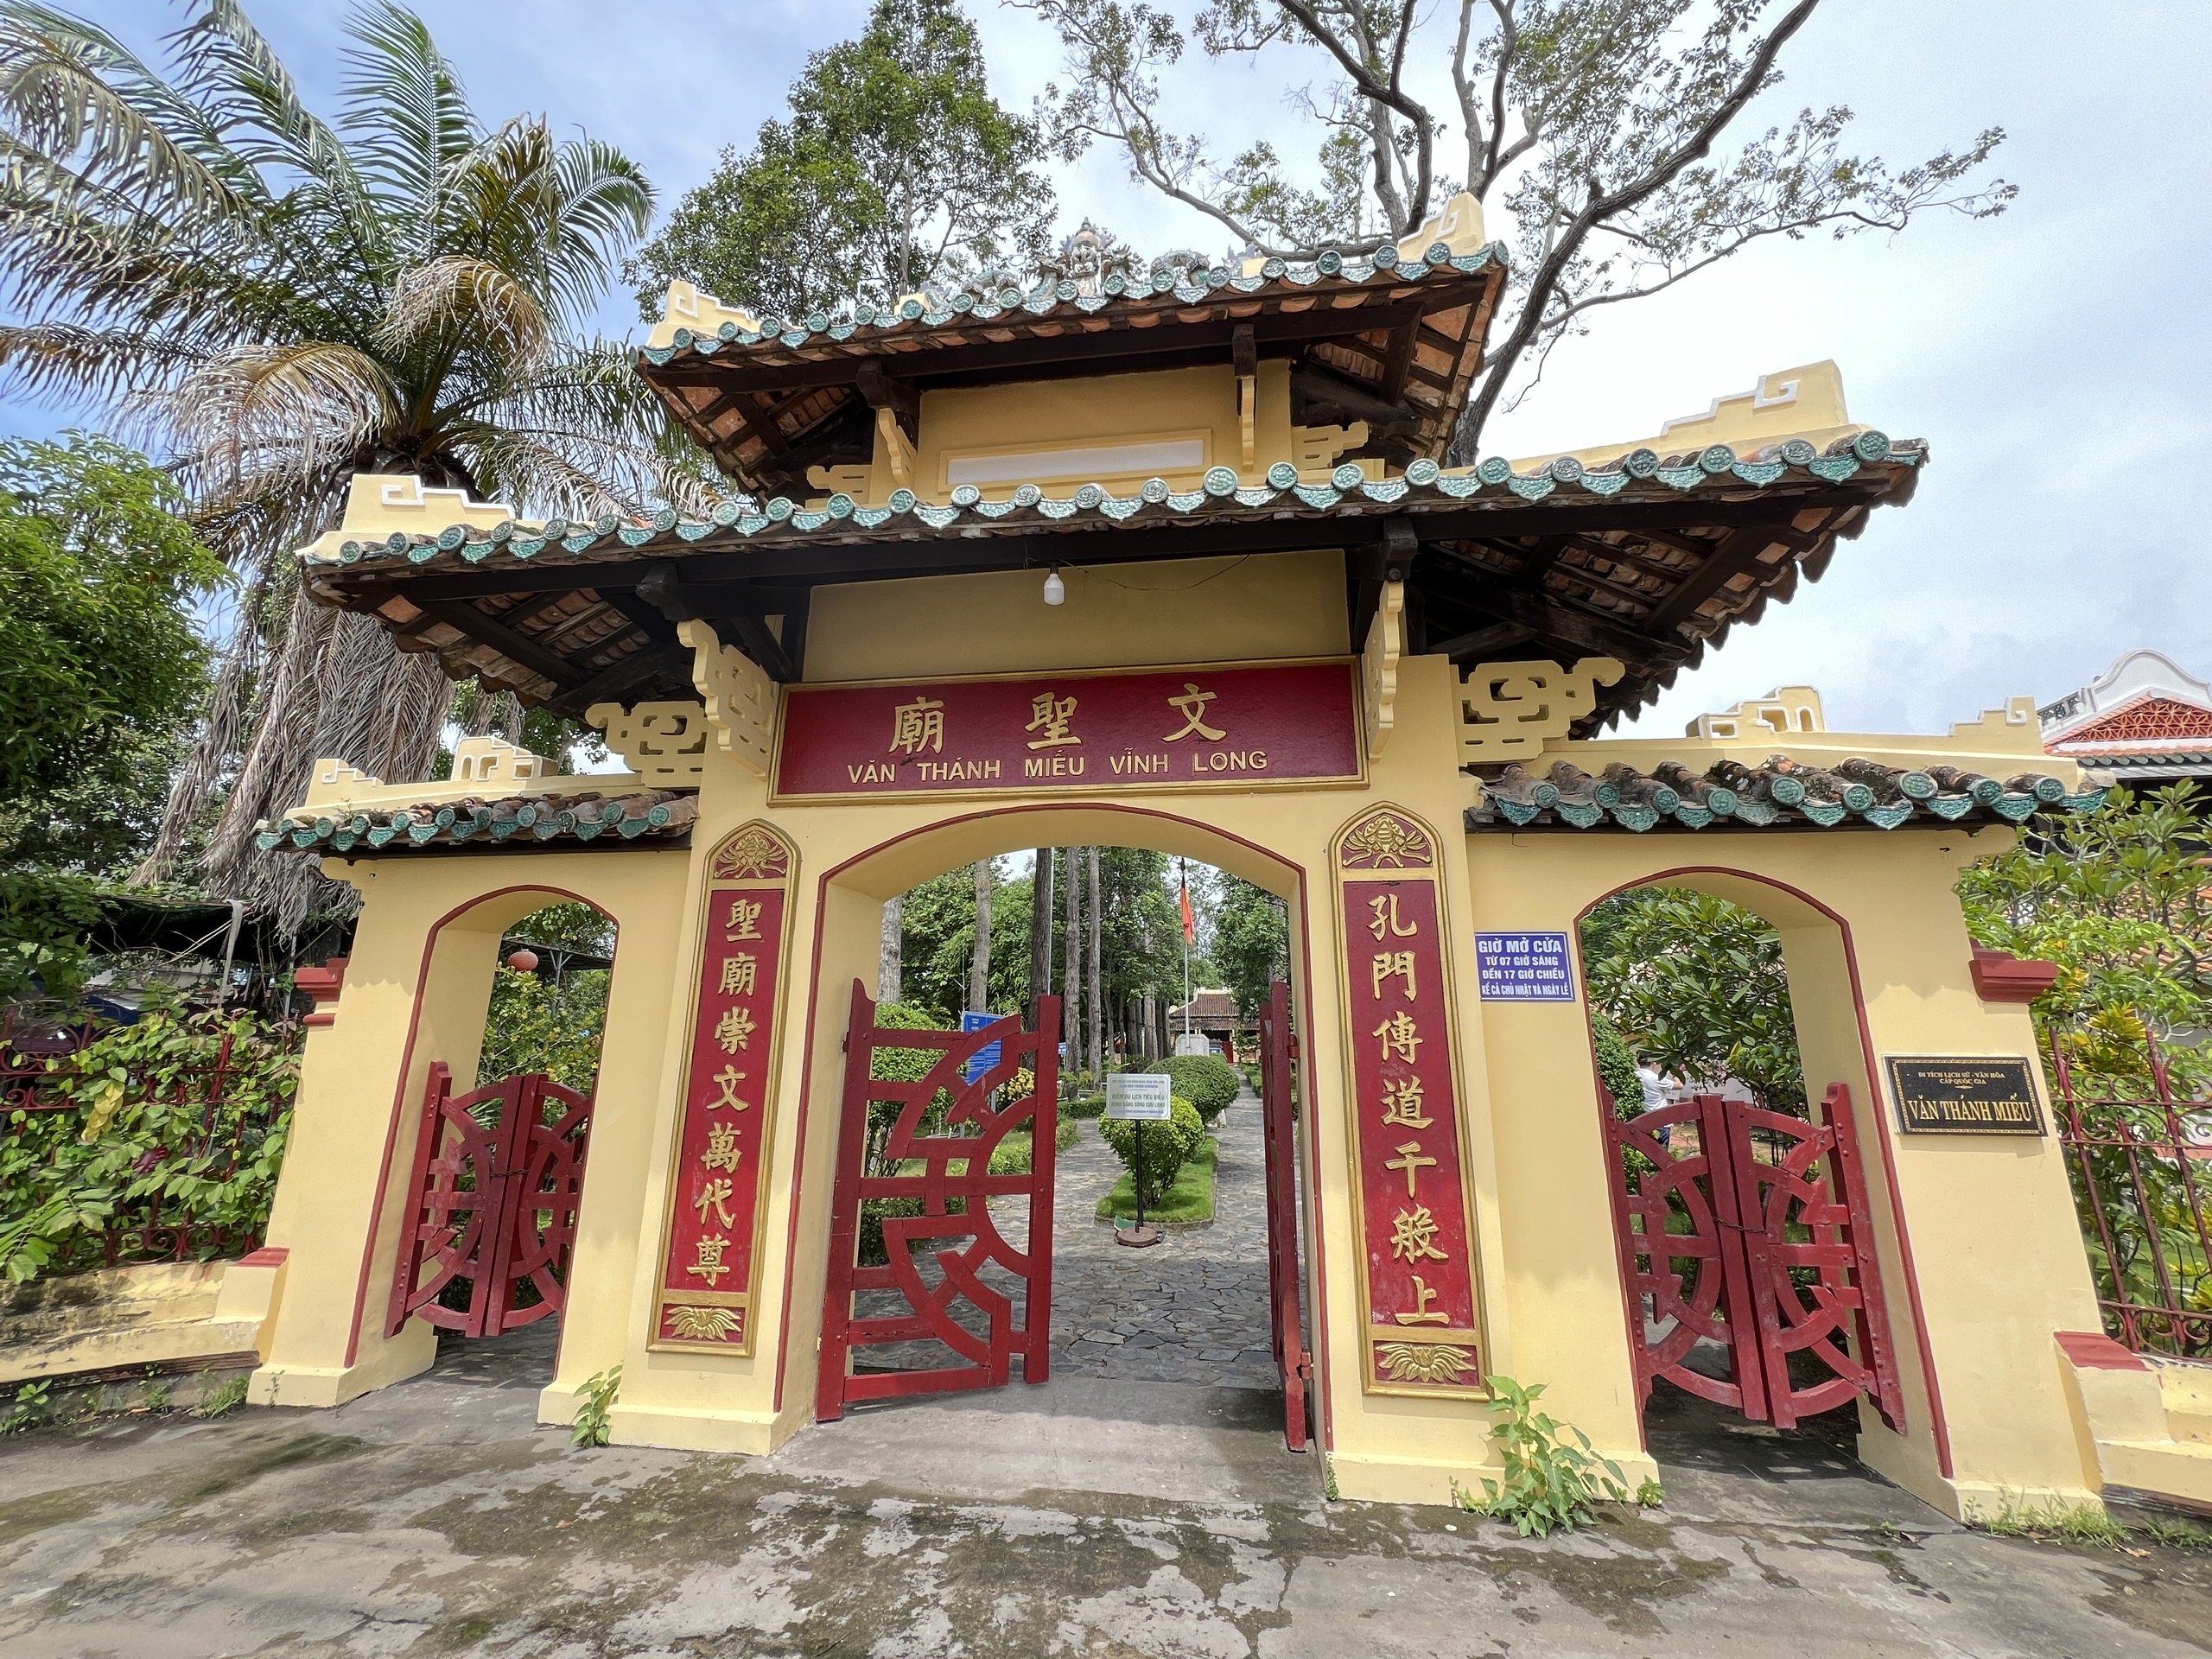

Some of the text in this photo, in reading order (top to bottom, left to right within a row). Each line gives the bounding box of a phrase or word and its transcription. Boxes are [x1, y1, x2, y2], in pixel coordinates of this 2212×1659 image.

[848, 747, 1268, 784] VĂN THÁNH MIẾU VĨNH LONG
[1478, 937, 1562, 953] GIỜ MỞ CỬA
[1485, 955, 1559, 966] TỪ 07 GIỜ SÁNG
[1482, 968, 1502, 979] ĐẾN
[1503, 969, 1516, 979] 17
[1517, 968, 1535, 979] GIỜ
[1532, 983, 1542, 995] VÀ
[1542, 983, 1560, 995] NGÀY
[1907, 1093, 2032, 1122] VĂN THÁNH MIẾU
